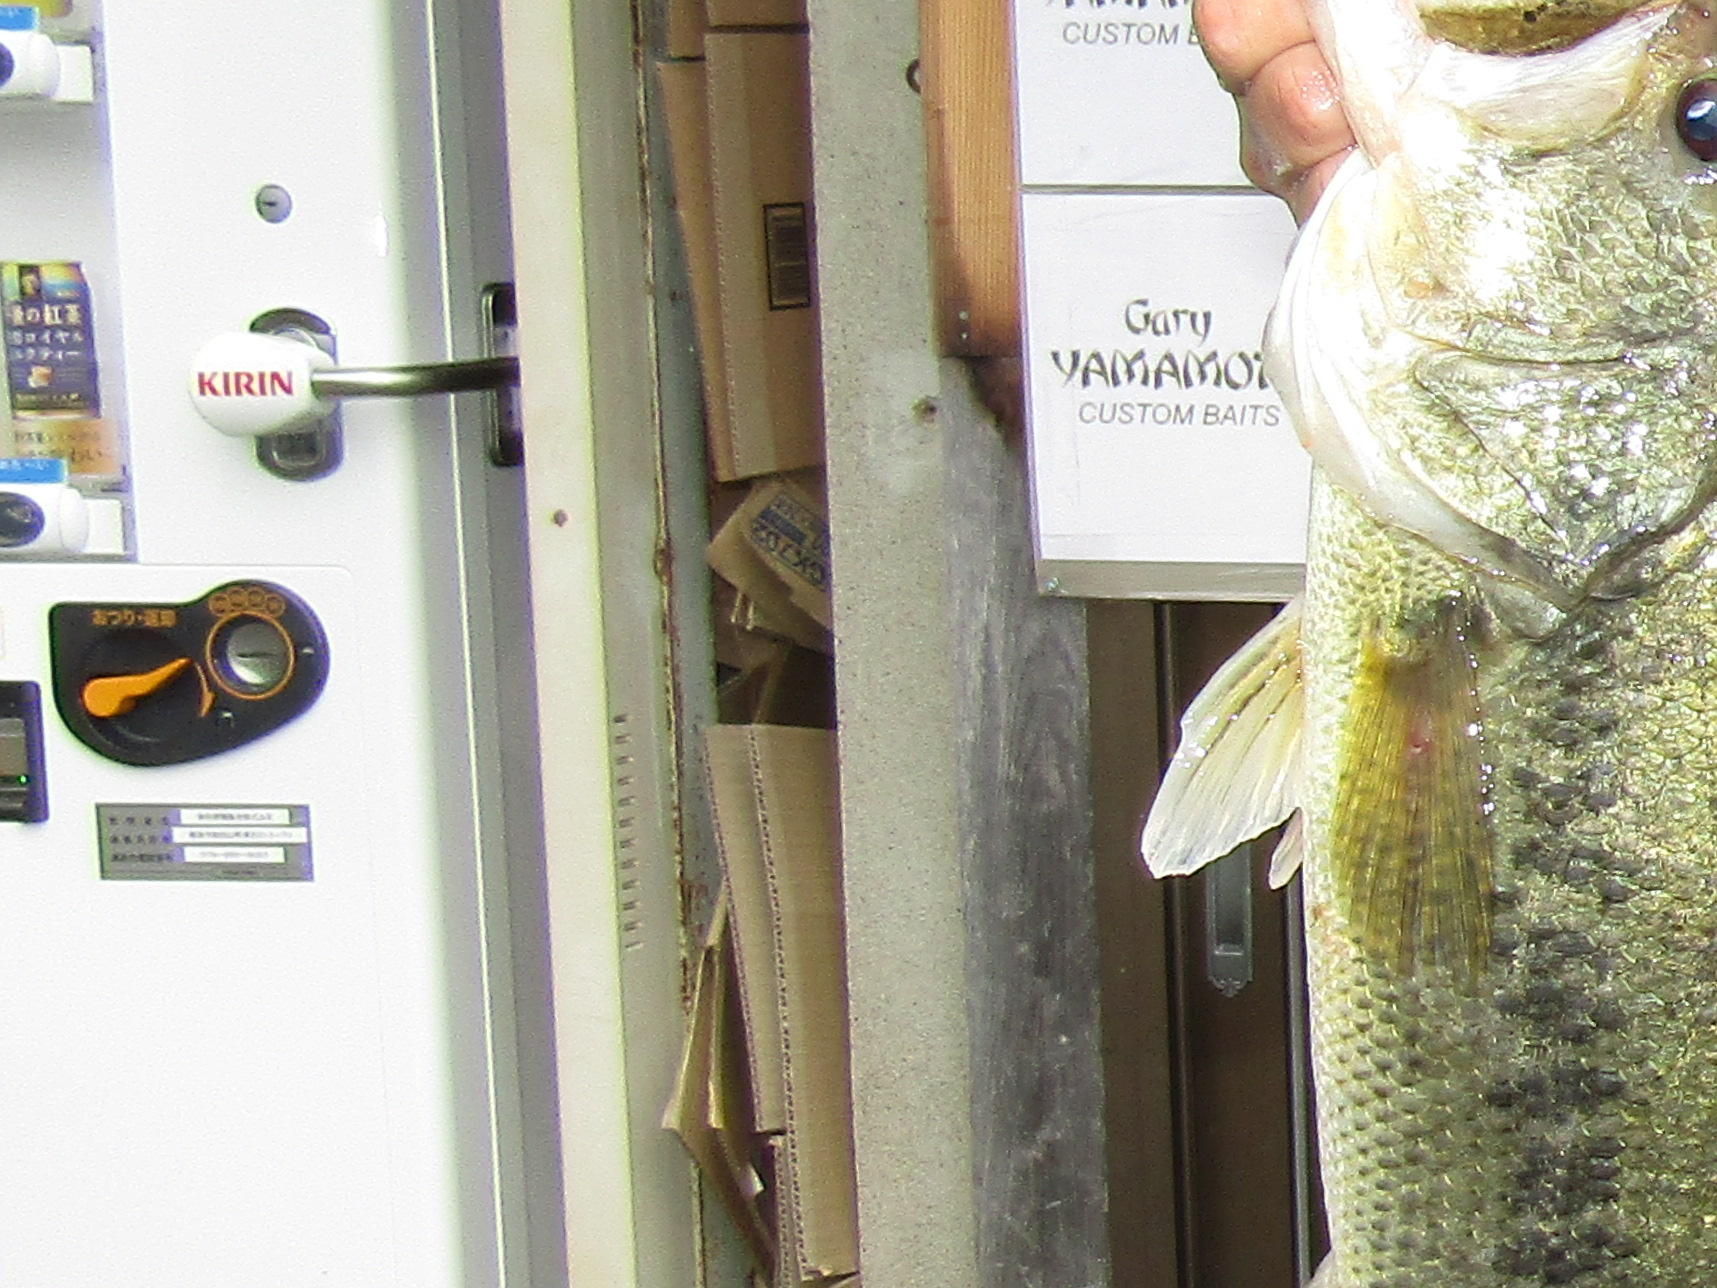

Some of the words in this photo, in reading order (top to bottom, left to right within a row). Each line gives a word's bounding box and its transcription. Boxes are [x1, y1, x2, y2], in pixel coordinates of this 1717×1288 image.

[1062, 21, 1180, 46] CUSTOM
[1124, 297, 1213, 347] Gary
[1050, 348, 1270, 391] YAMAMOT
[197, 370, 295, 397] KIRIN
[1078, 401, 1196, 425] CUSTOM
[1201, 402, 1282, 427] BAITS
